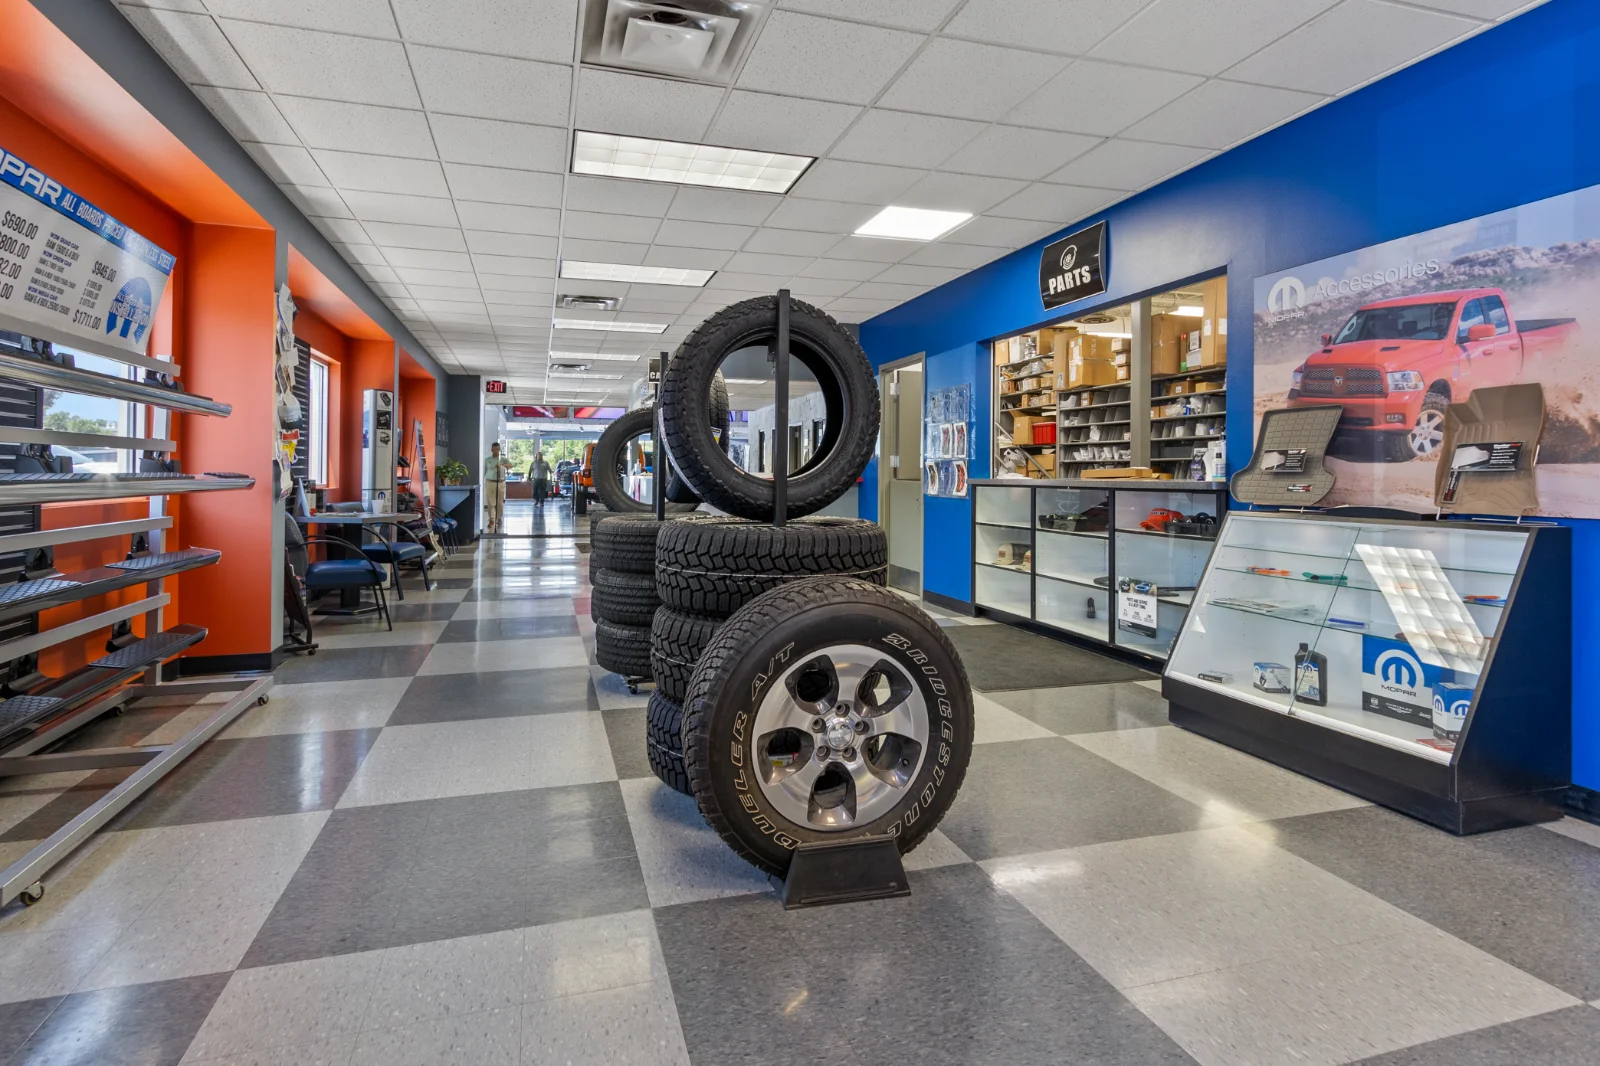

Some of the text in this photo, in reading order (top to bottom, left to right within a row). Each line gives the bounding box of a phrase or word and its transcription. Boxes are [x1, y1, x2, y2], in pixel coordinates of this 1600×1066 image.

[0, 148, 62, 205] PAR
[2, 210, 39, 240] $690.00
[61, 193, 77, 213] ALL
[77, 201, 104, 228] BOARDS
[0, 231, 30, 260] 800.00
[92, 260, 117, 283] $945.00
[1048, 265, 1092, 295] PARTS
[1314, 258, 1440, 301] Accessories
[72, 309, 102, 331] $1711.00
[1268, 311, 1305, 323] MOPAR
[489, 382, 503, 392] EXIT
[1381, 684, 1417, 697] MOPAR
[731, 641, 801, 850] DUELER A/T
[882, 633, 953, 838] BRIDGESTONE
